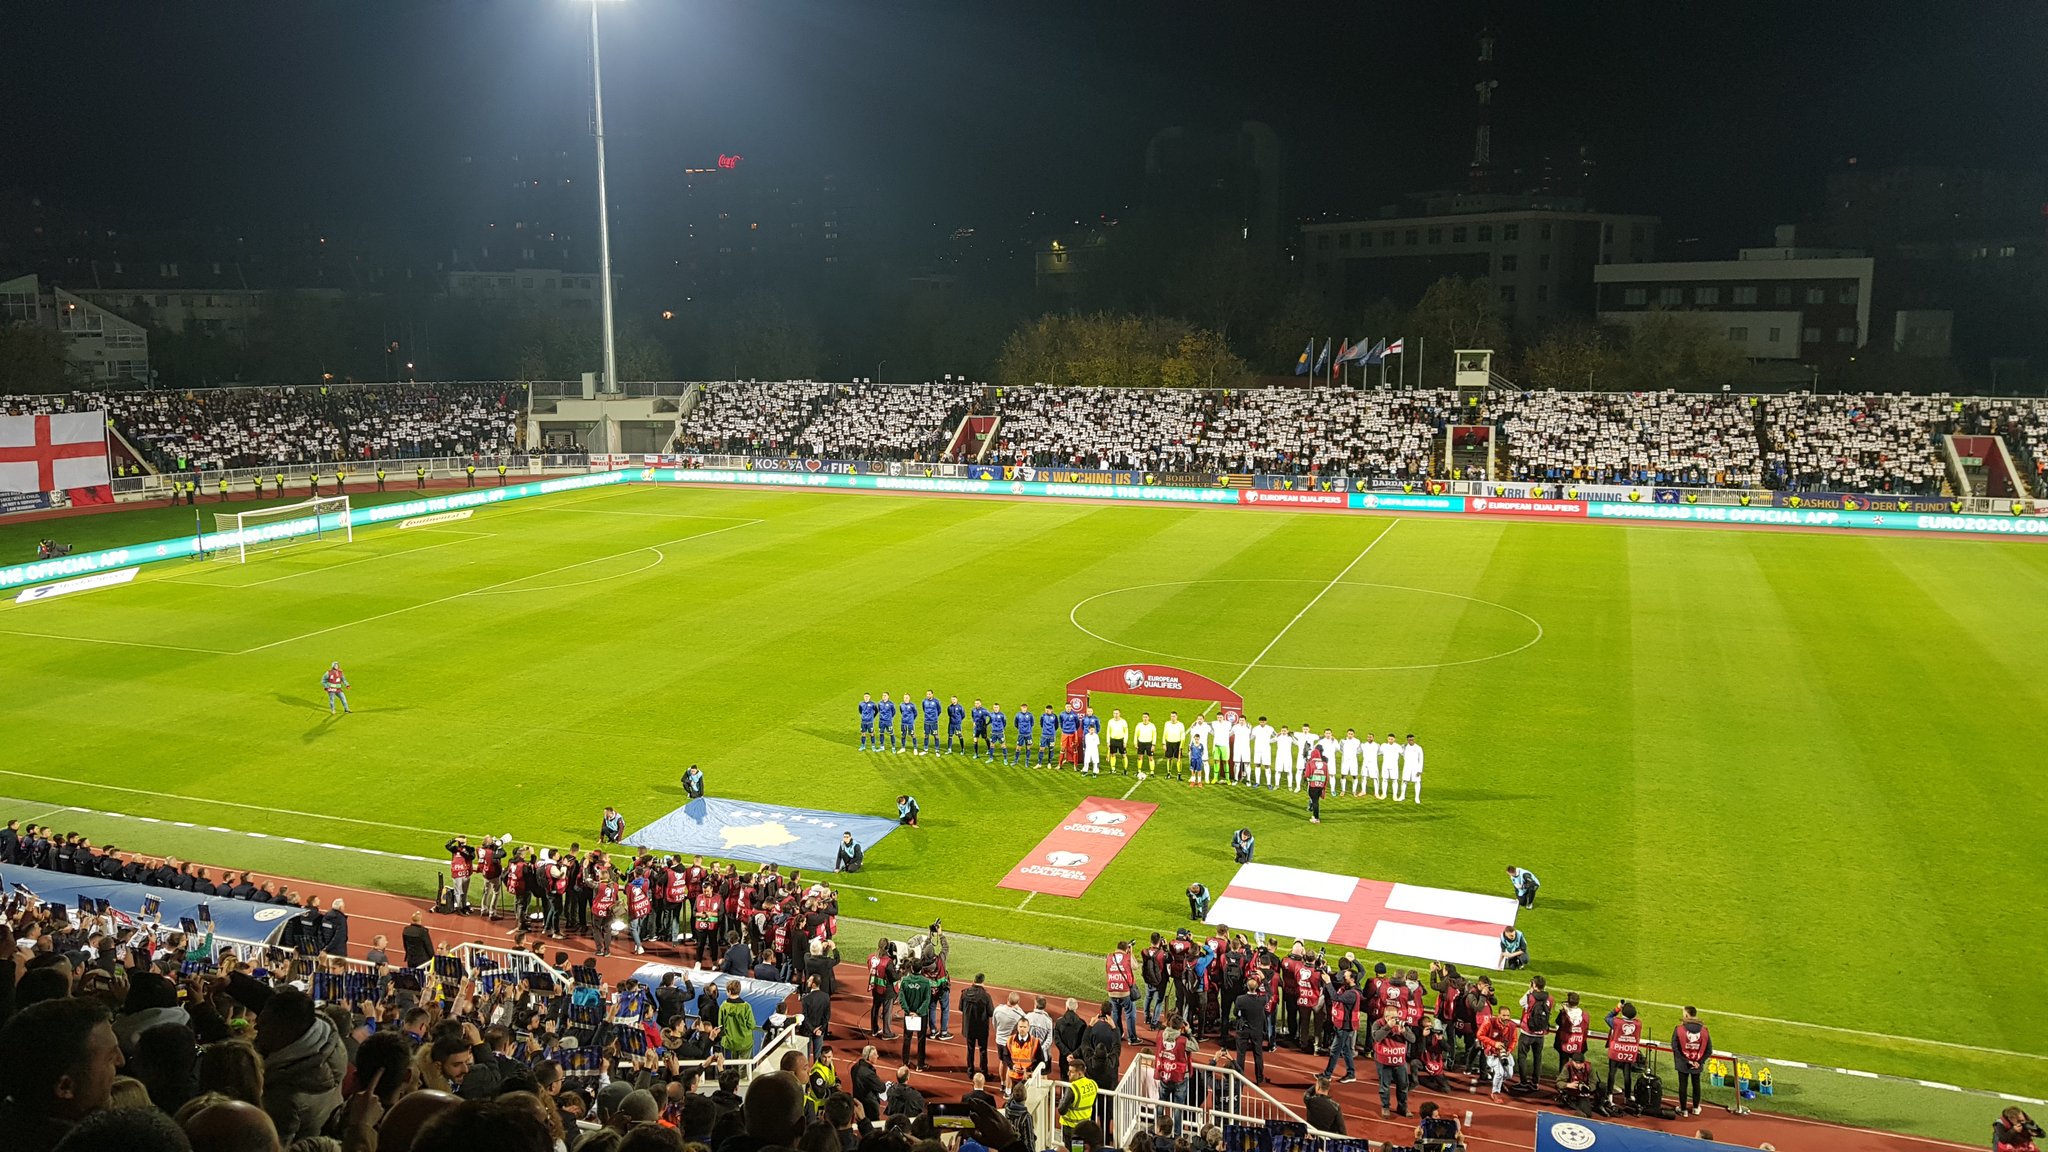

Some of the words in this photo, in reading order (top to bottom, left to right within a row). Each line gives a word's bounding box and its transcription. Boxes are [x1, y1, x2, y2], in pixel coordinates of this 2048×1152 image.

[831, 463, 853, 474] FIF
[807, 475, 829, 486] APP
[1038, 471, 1050, 482] IS
[1053, 471, 1113, 484] WACHING
[1115, 473, 1131, 485] US
[1046, 484, 1114, 498] DOWNLOAD
[1117, 486, 1140, 499] THE
[1142, 487, 1198, 501] OFFICIAL
[1201, 490, 1227, 502] APP
[1487, 485, 1525, 499] VKRRI
[1576, 491, 1622, 502] HINNING
[1259, 494, 1299, 503] EUROPEAN
[1300, 495, 1342, 504] QUALIFIERS
[1488, 501, 1531, 510] EUROPEAN
[1533, 503, 1581, 513] QUALIFIERS
[1871, 499, 1897, 511] DERI
[1914, 502, 1948, 512] FUNDI
[1602, 504, 1692, 519] DOWNLOAD
[1695, 507, 1726, 520] THE
[1729, 509, 1802, 523] OFFICIAL
[1804, 511, 1840, 525] APP
[26, 555, 98, 580] OFFICIAL
[100, 549, 129, 568] APP
[1147, 675, 1179, 683] EUROPEAN
[1143, 680, 1183, 690] QUALIFIERS
[671, 887, 685, 895] PHOT
[1110, 982, 1124, 991] 024
[1382, 1046, 1406, 1056] PHOTO
[1614, 1043, 1638, 1053] PHOTO
[1387, 1056, 1403, 1065] 104
[1617, 1052, 1634, 1061] 072
[1081, 1083, 1093, 1094] 239
